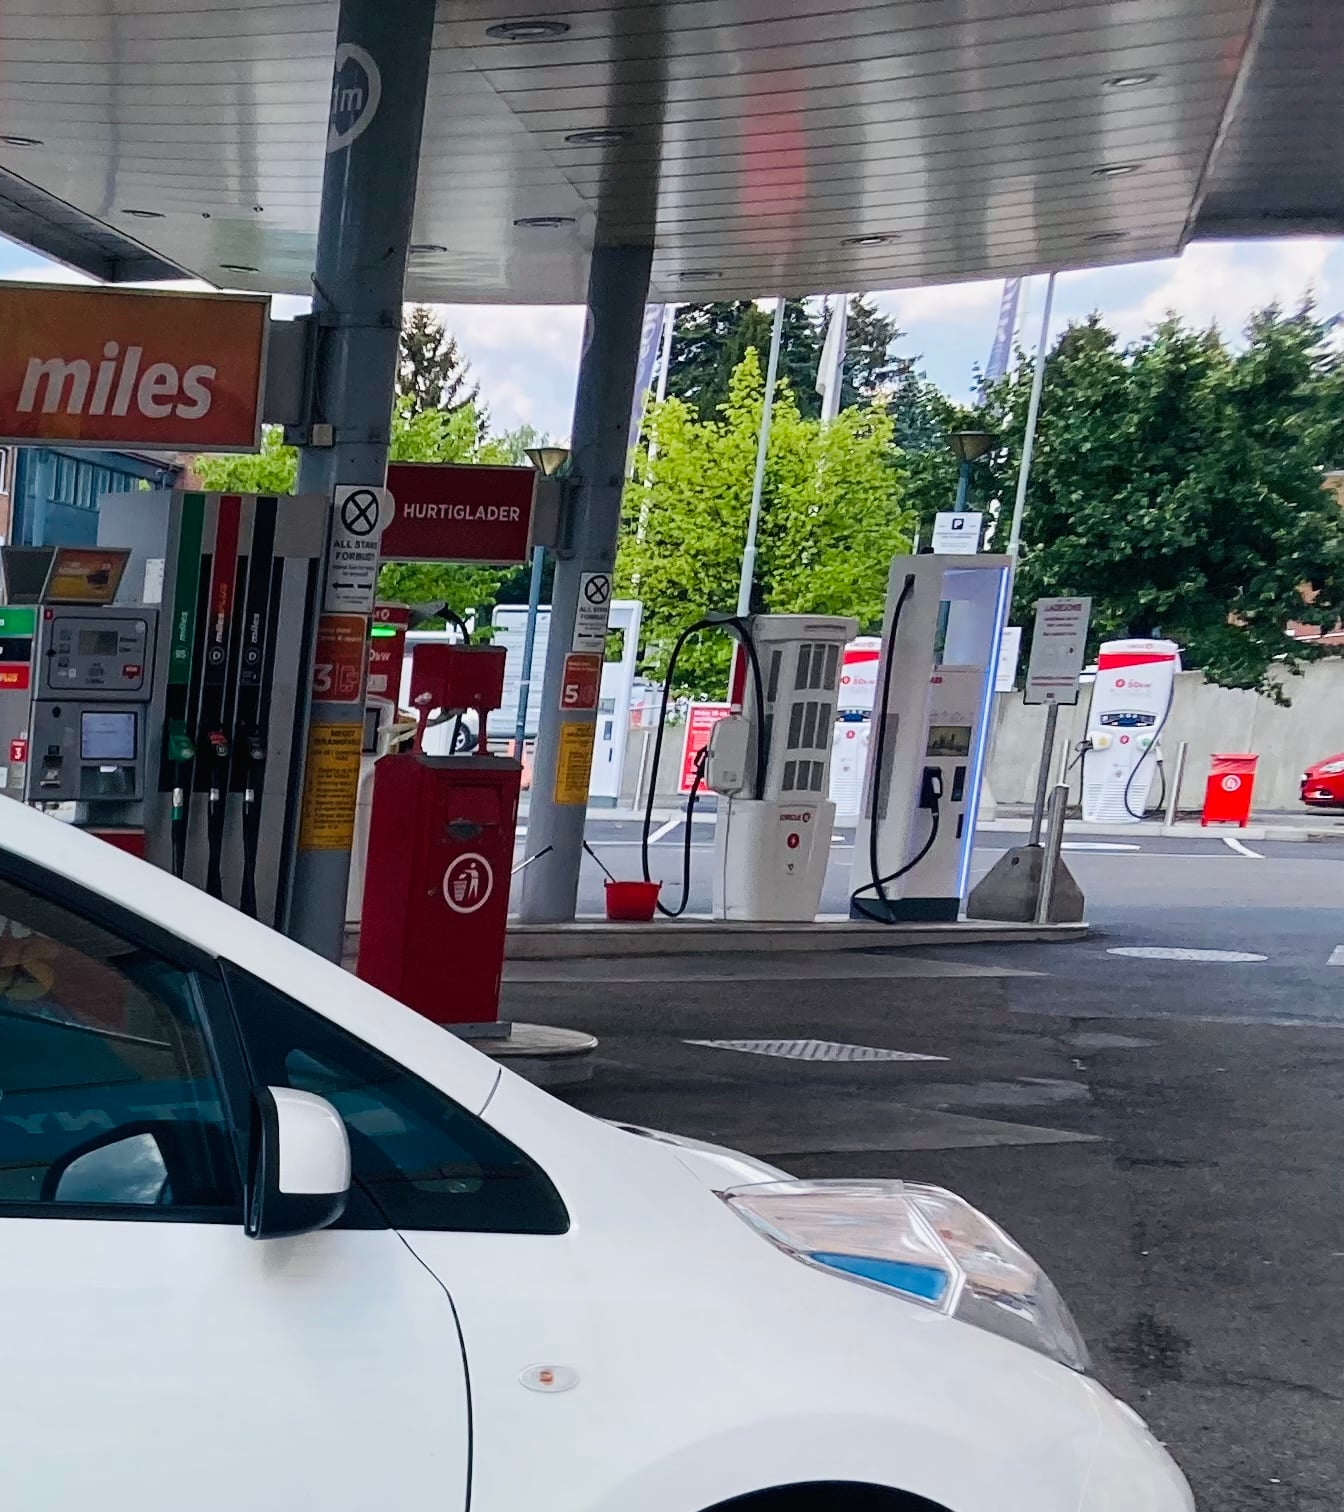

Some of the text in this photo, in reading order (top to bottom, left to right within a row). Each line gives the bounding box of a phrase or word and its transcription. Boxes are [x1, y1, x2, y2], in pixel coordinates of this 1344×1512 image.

[16, 341, 217, 419] miles
[404, 504, 520, 521] HURTIGLADER
[564, 684, 579, 703] 5
[14, 747, 22, 760] 3
